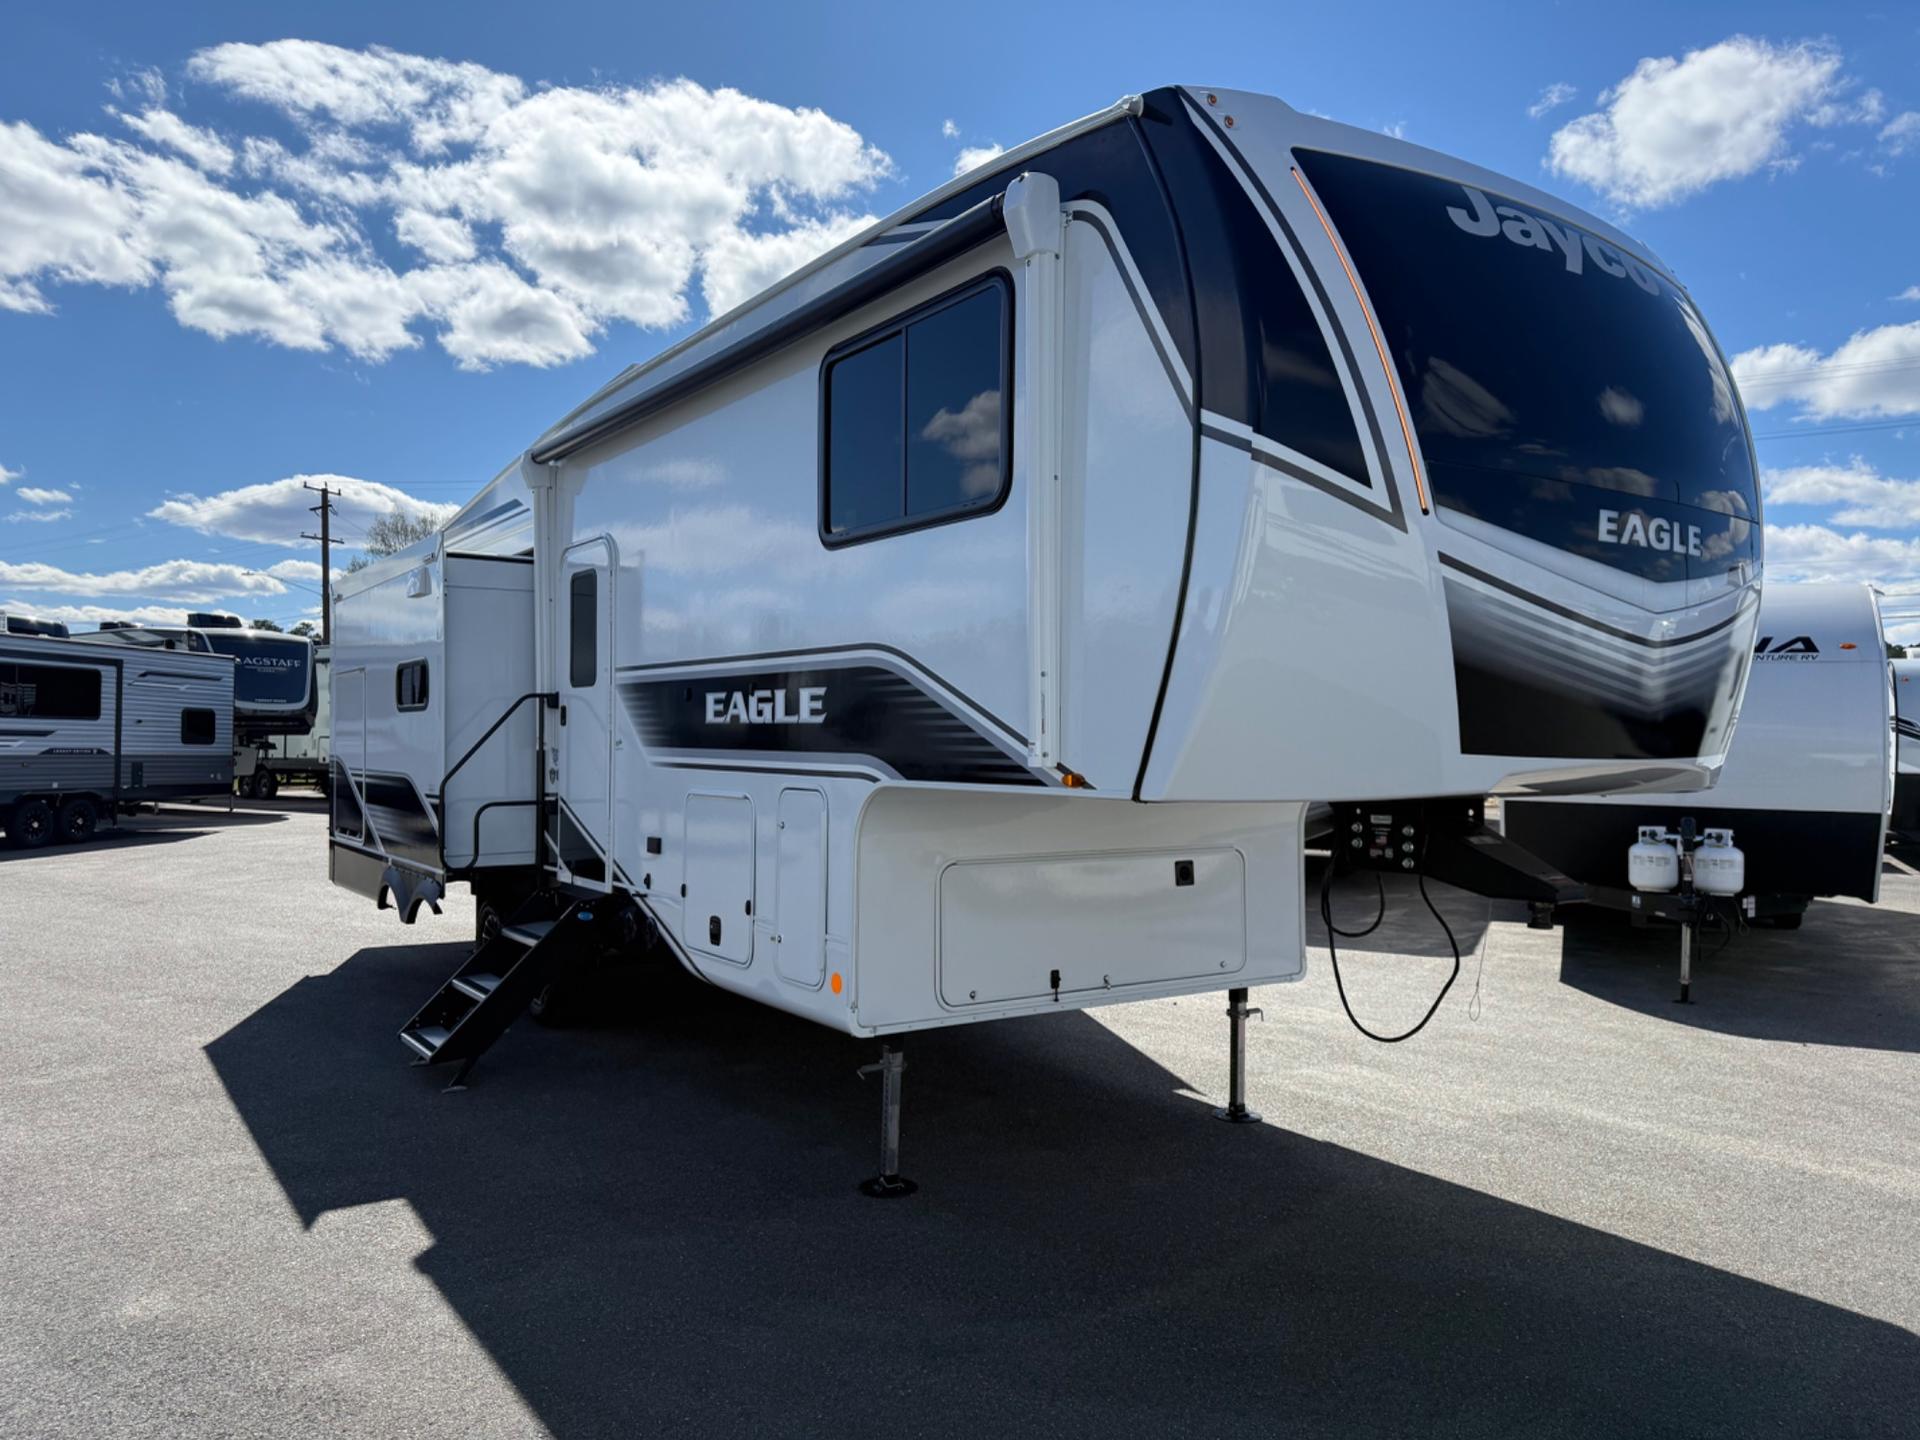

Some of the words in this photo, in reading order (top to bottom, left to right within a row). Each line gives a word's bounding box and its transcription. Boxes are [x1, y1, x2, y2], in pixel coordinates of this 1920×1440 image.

[1598, 508, 1702, 557] EAGLE
[239, 656, 302, 668] AGSTAFF
[705, 686, 828, 725] EAGLE
